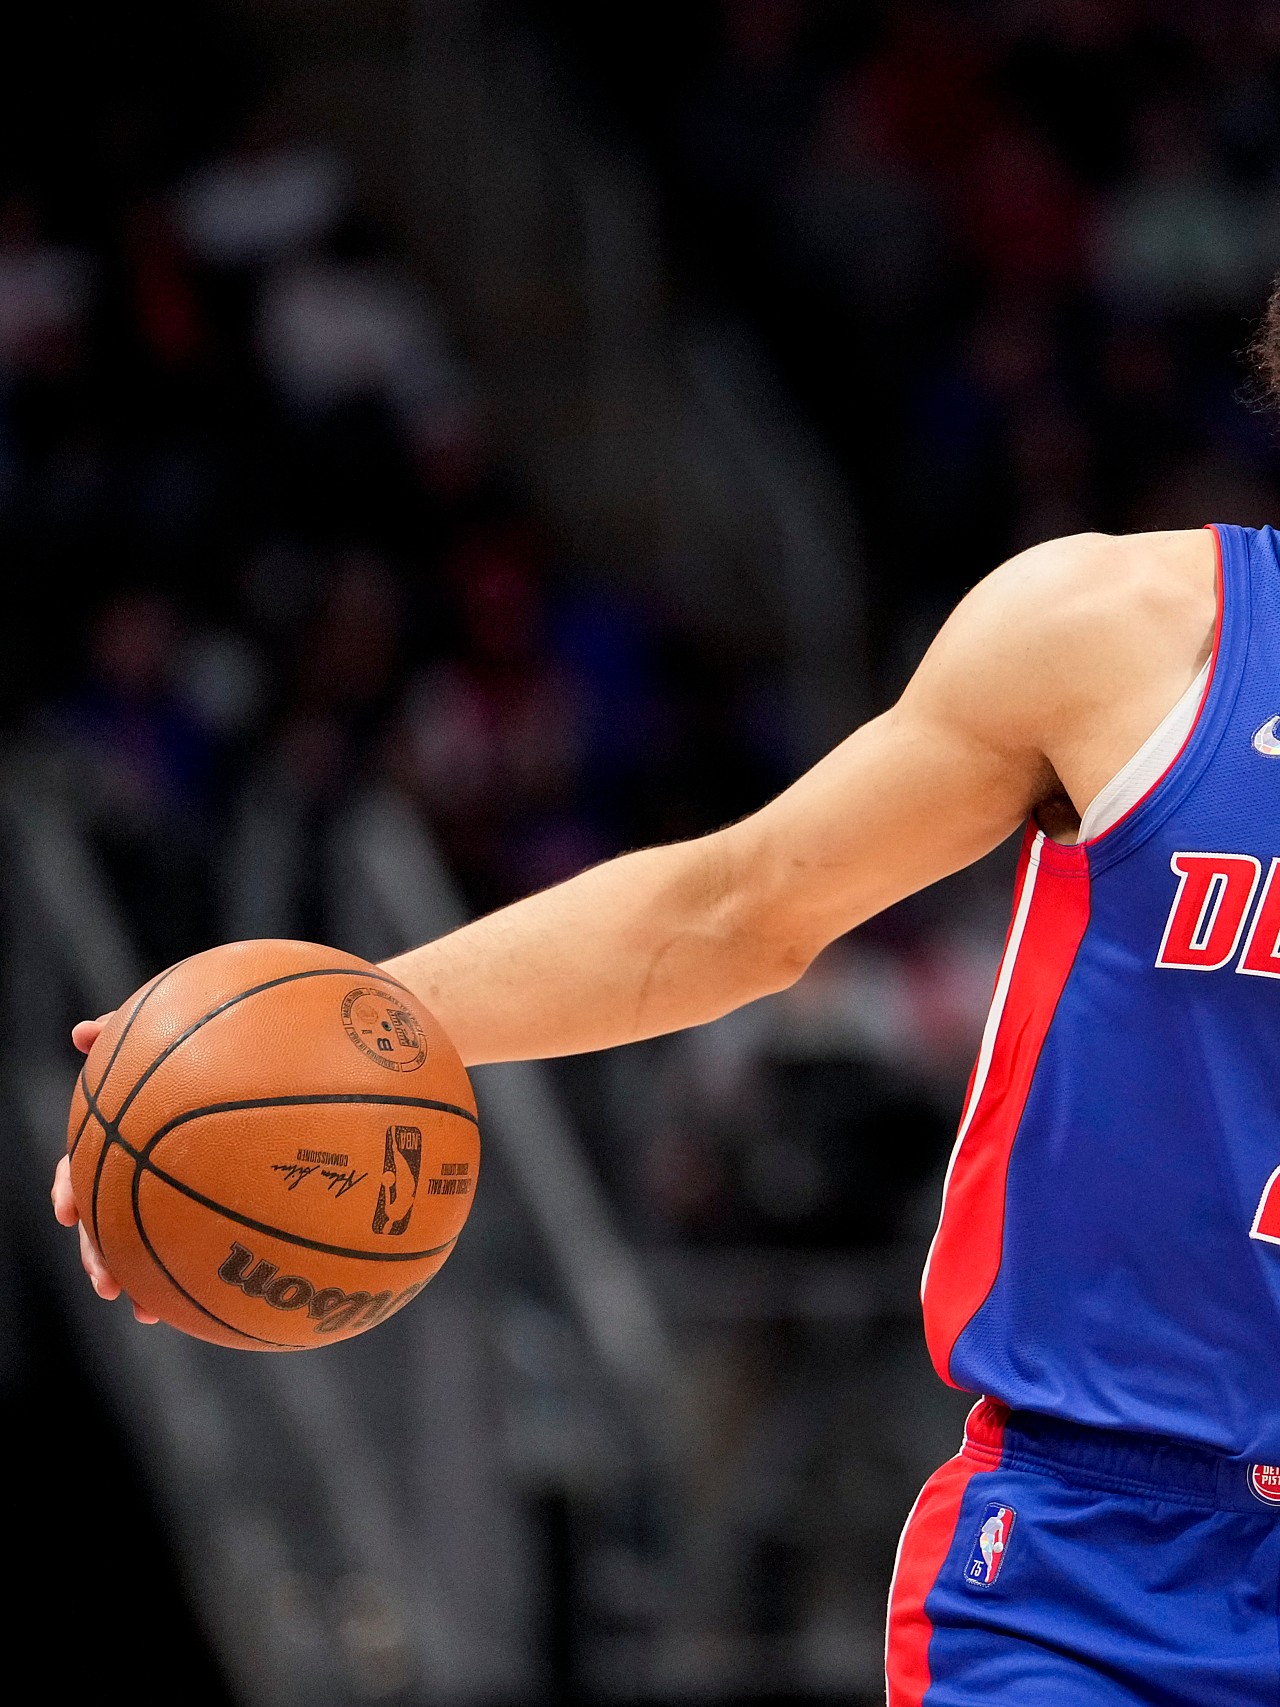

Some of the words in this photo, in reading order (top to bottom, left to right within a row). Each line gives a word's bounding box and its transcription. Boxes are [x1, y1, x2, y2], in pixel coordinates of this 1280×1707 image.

[400, 1132, 418, 1150] NBA
[296, 1148, 349, 1167] COMMISSIONER
[970, 1559, 984, 1577] 75
